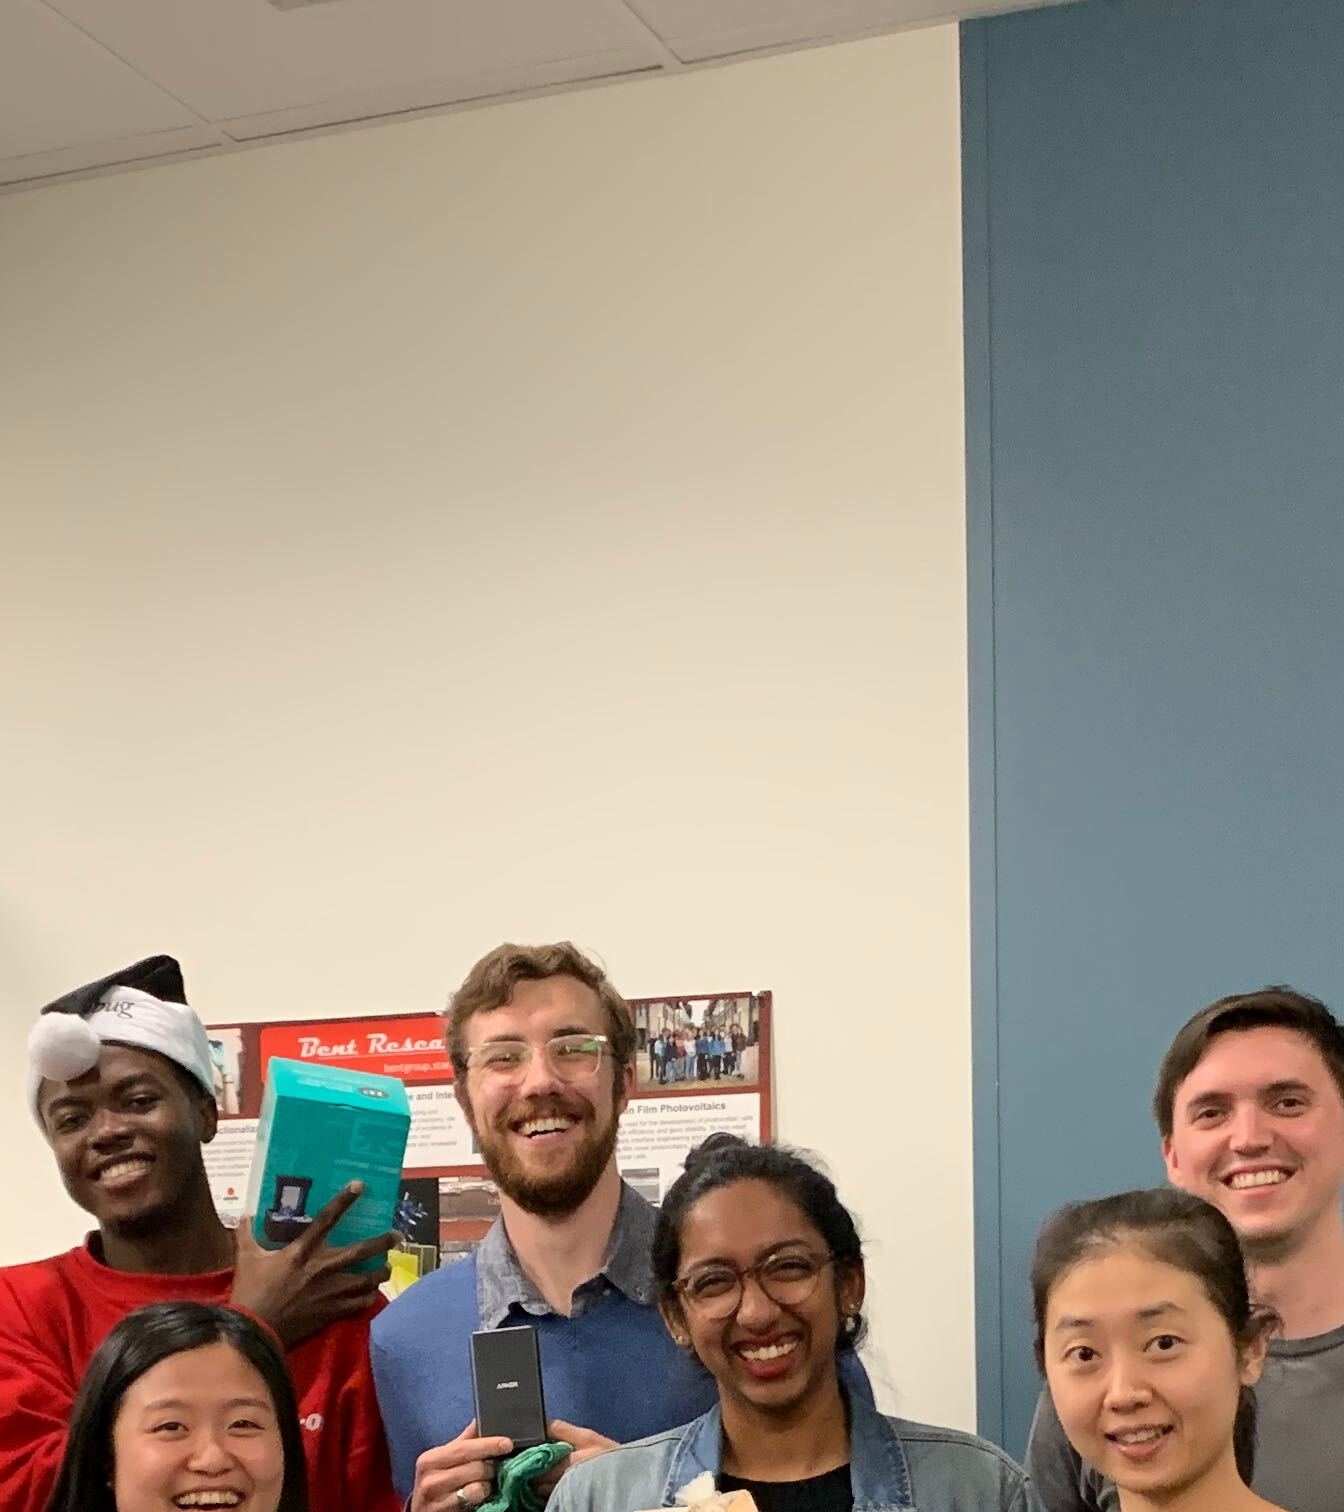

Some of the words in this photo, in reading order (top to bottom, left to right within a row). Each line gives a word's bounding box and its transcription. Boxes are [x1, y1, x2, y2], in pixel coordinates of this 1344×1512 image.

[298, 1037, 358, 1057] Bent
[637, 1105, 657, 1114] Film
[660, 1102, 726, 1113] Photovoltaics
